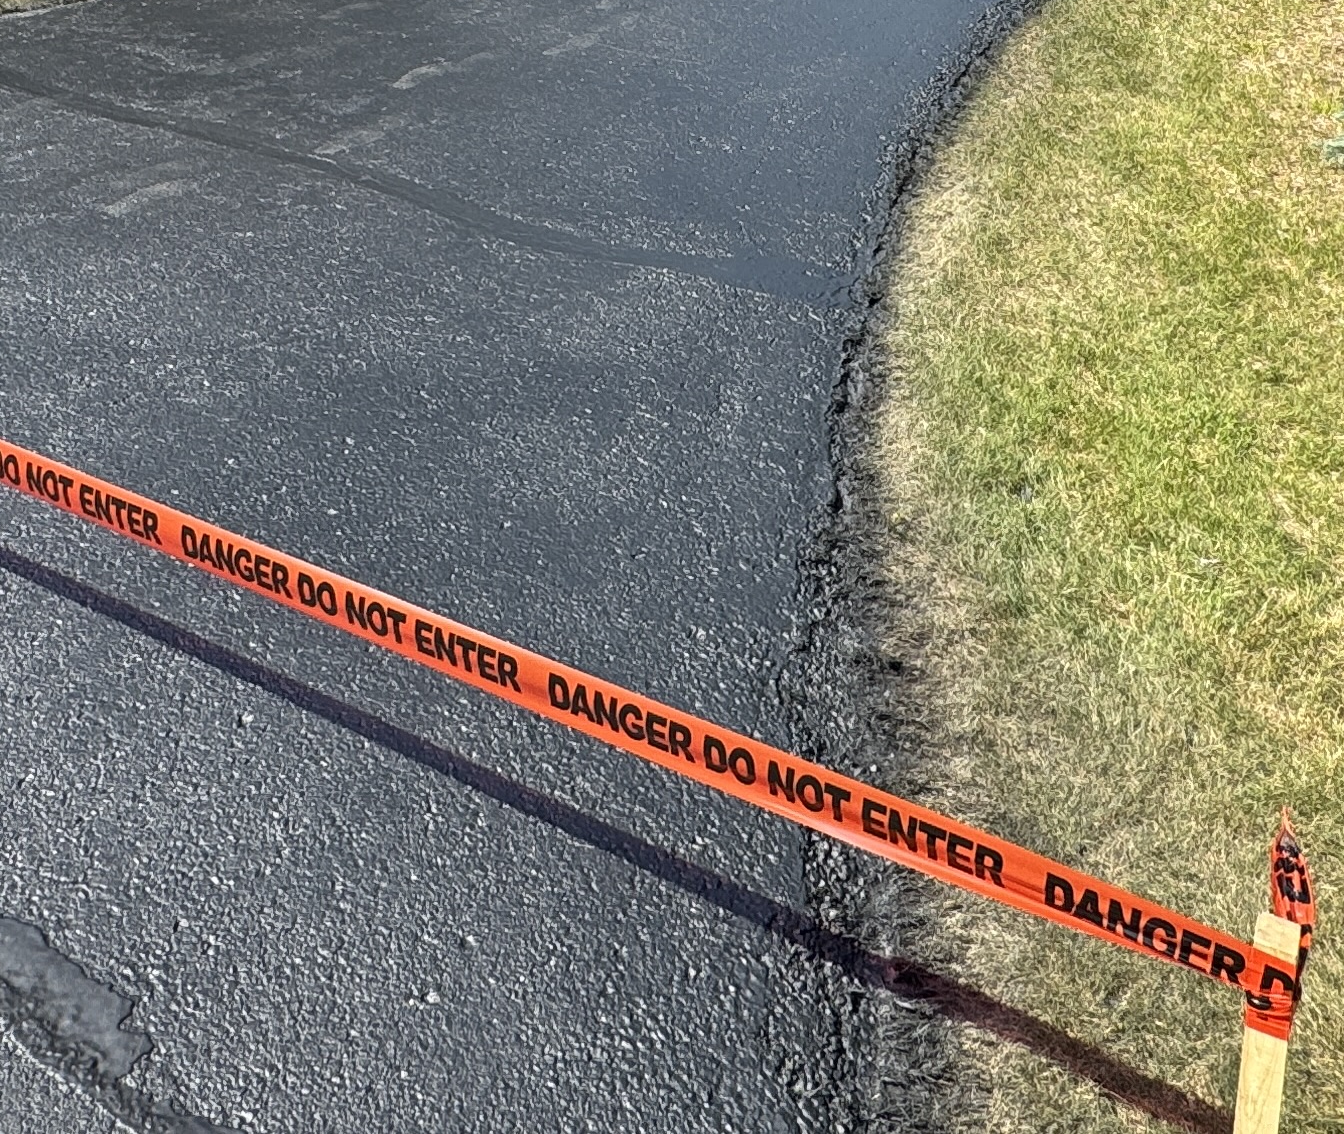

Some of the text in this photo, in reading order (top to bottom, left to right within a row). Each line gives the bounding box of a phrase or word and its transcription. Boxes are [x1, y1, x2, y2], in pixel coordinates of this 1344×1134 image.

[26, 462, 74, 507] NOT
[79, 483, 163, 546] ENTER
[181, 525, 522, 694] DANGER DO NOT ENTER
[548, 672, 1006, 888] DANGER DO NOT ENTER
[1044, 871, 1247, 986] DANGER
